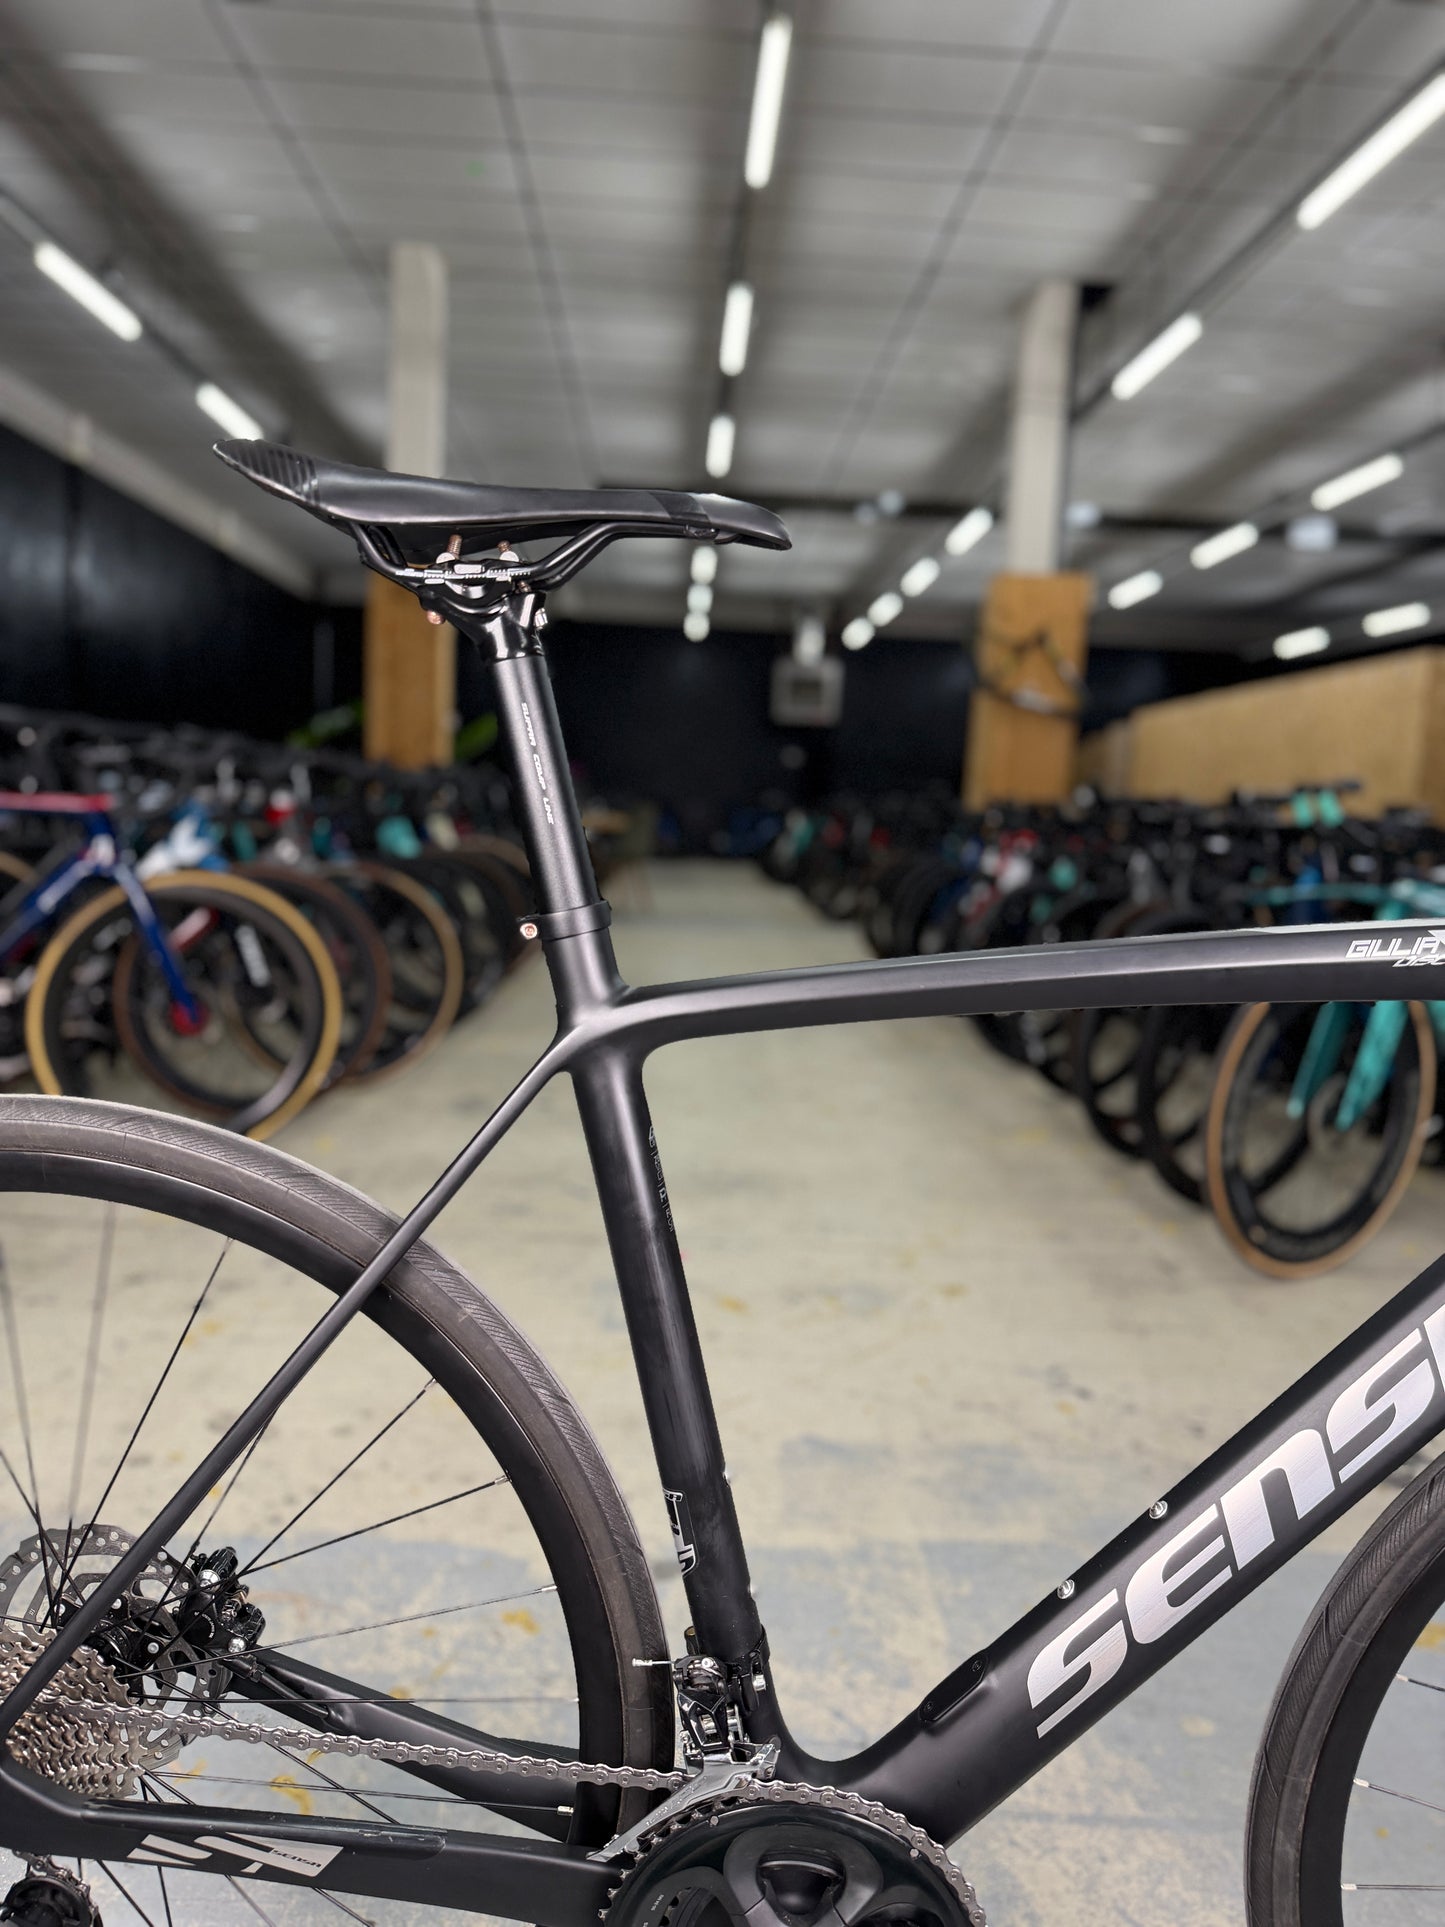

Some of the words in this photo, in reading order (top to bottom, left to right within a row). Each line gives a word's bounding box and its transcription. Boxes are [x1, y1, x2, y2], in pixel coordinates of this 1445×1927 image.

[521, 702, 536, 747] SUPRA
[533, 753, 546, 790] COMP
[543, 797, 555, 825] LINE
[1345, 937, 1440, 958] GIULIA
[1027, 1303, 1445, 1739] sens
